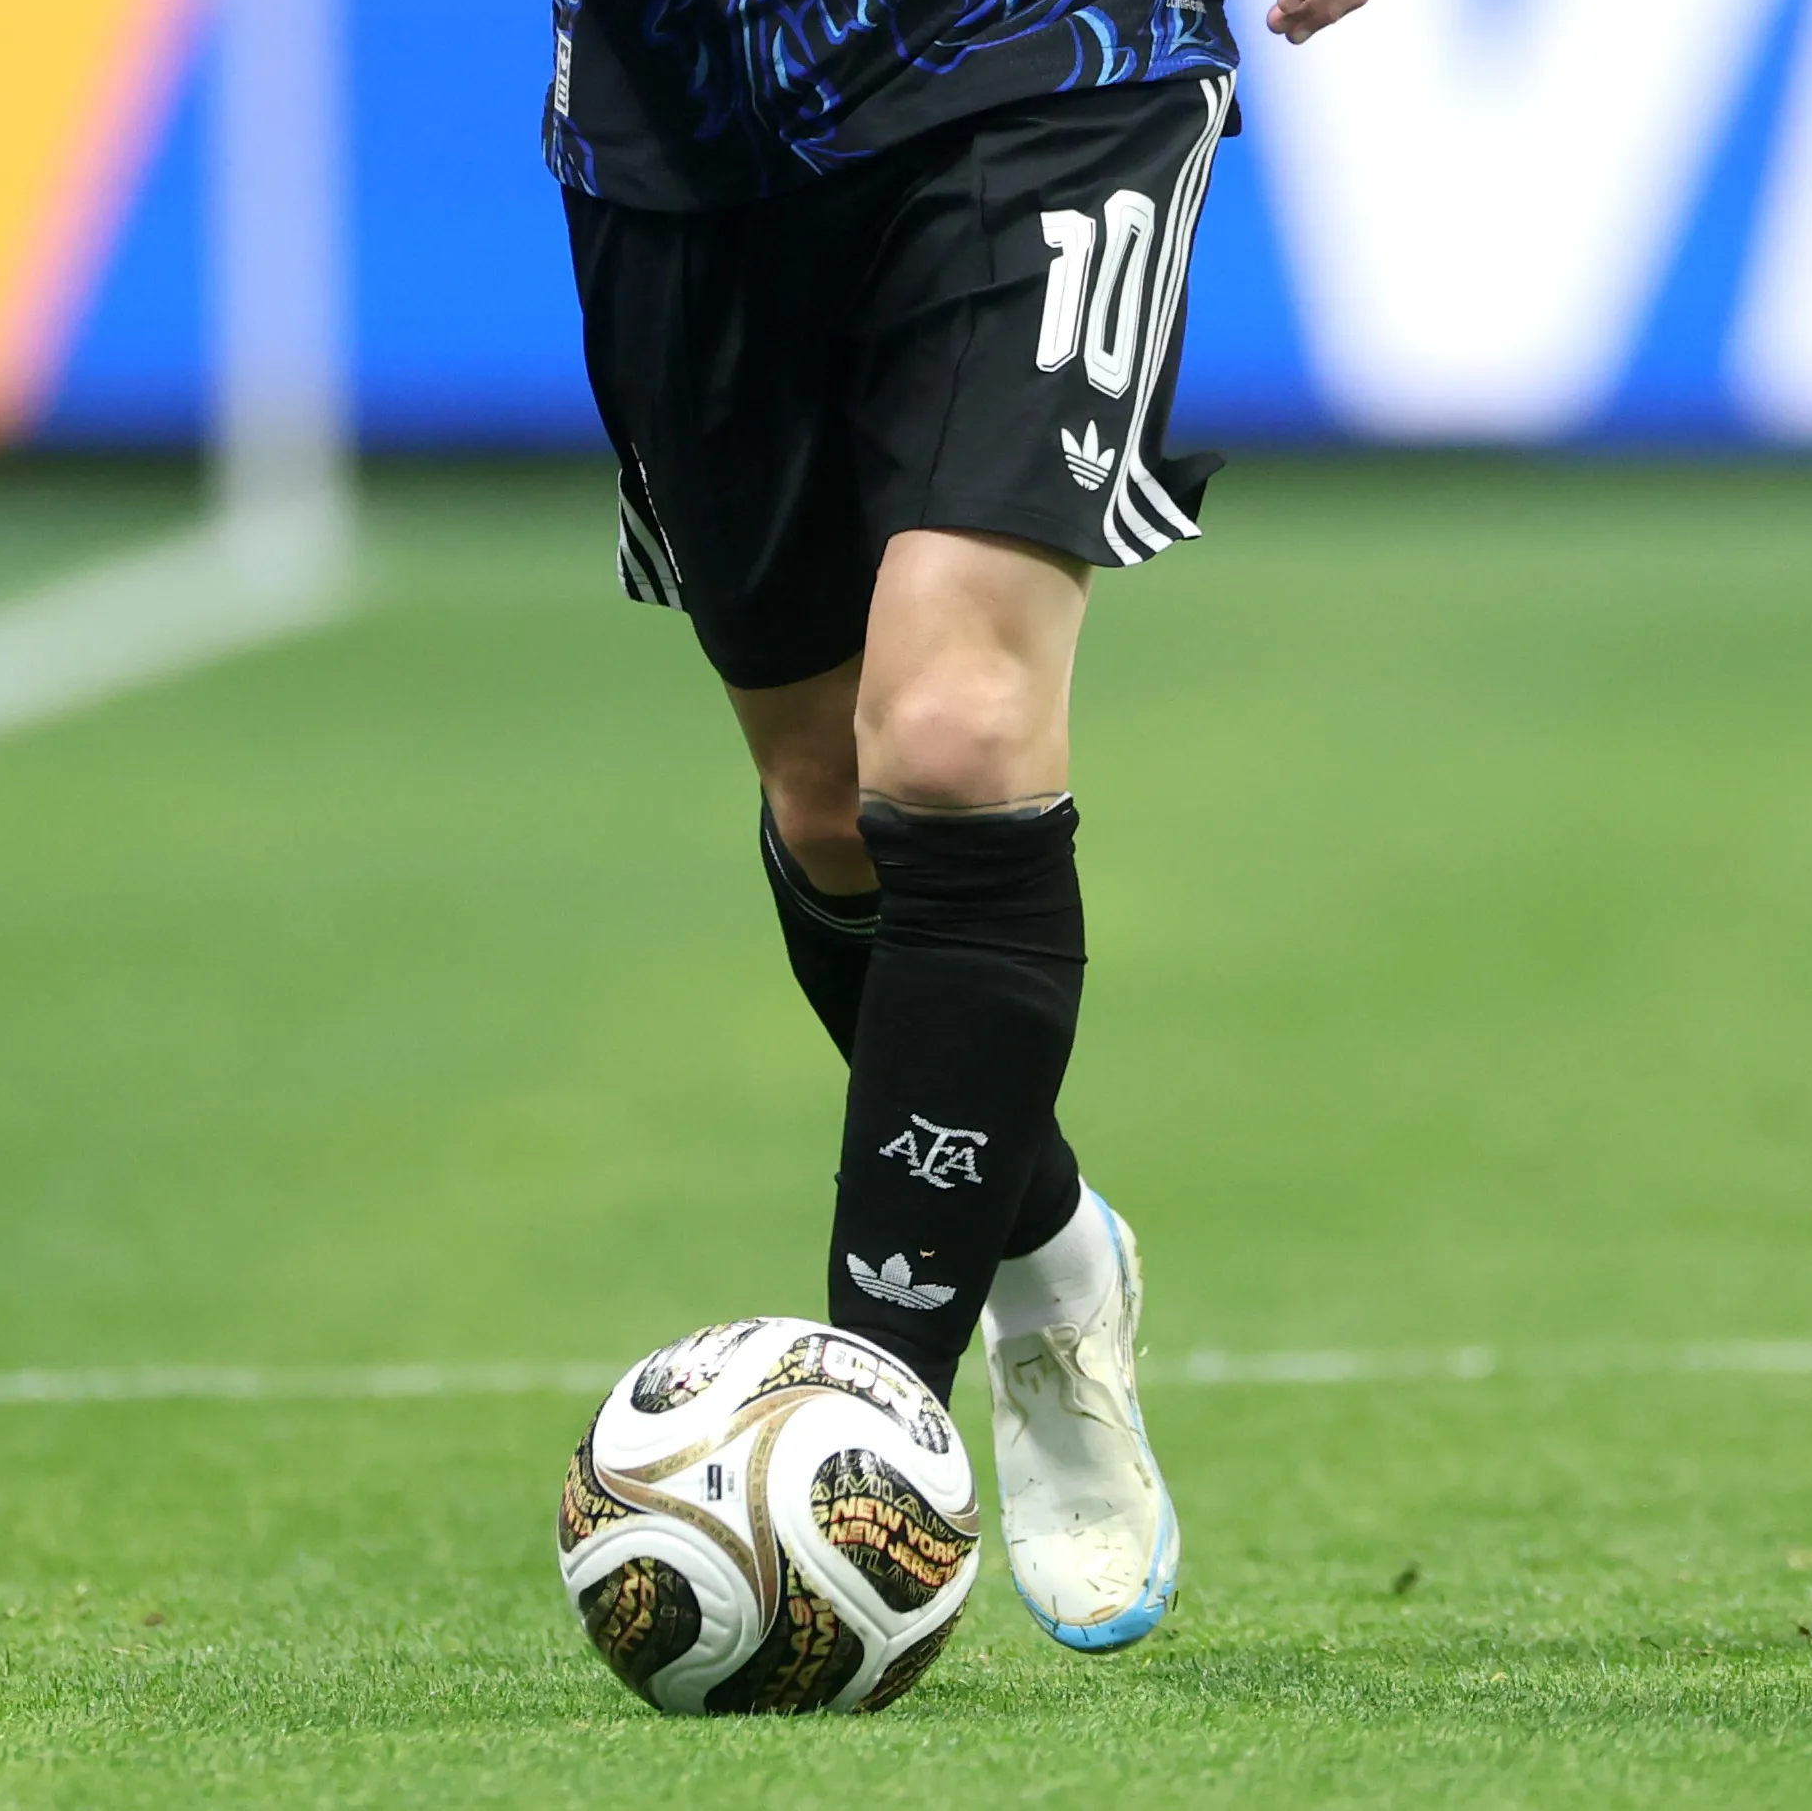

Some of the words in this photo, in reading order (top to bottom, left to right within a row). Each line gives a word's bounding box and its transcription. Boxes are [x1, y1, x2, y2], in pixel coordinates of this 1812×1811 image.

[1035, 189, 1155, 400] 10
[878, 1113, 989, 1189] AFA
[828, 1520, 888, 1550] NEW
[887, 1542, 960, 1587] JERSEY
[830, 1496, 903, 1532] NEW
[905, 1518, 960, 1565] YORK
